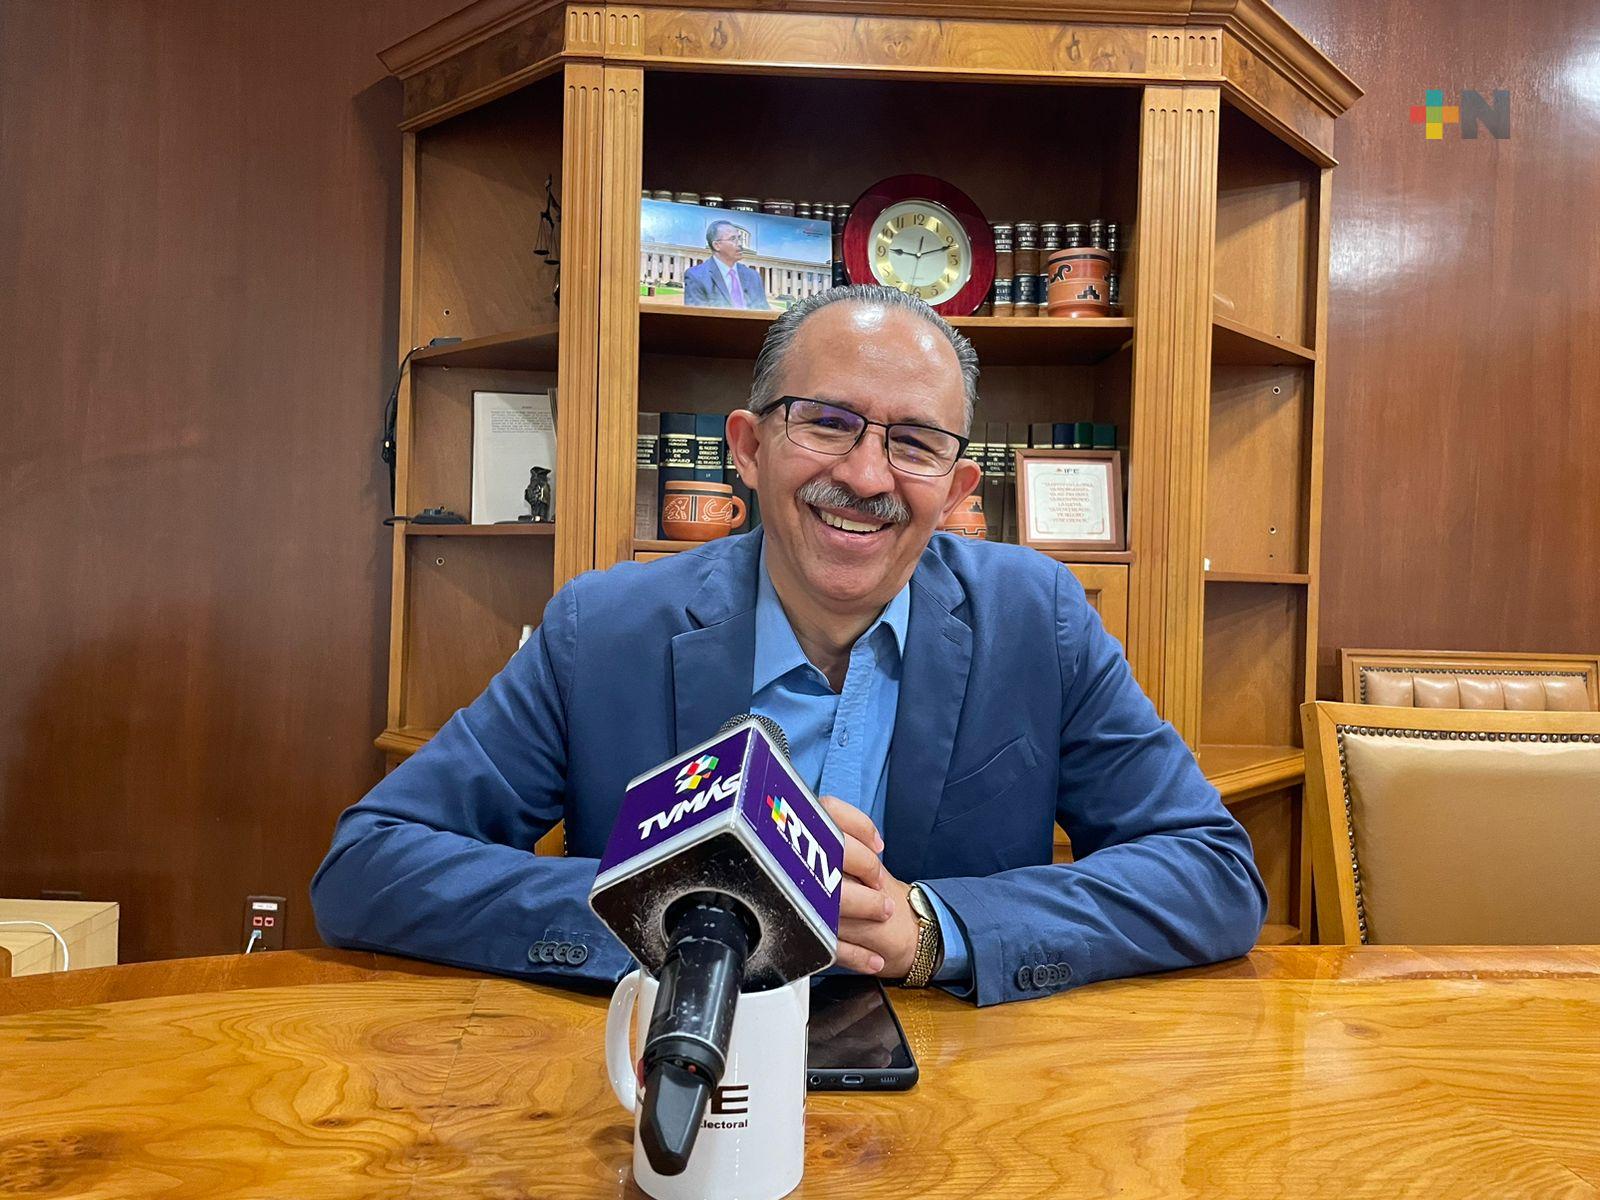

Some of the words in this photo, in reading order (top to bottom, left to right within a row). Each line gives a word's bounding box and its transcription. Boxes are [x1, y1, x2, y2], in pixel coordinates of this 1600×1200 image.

[896, 216, 904, 228] 11
[913, 214, 925, 226] 12
[882, 228, 894, 239] 10
[936, 222, 940, 233] 1
[877, 246, 886, 257] 9
[951, 254, 959, 266] 3
[931, 285, 939, 296] 5
[638, 772, 741, 840] TVMÁS
[777, 796, 842, 894] RTV
[710, 1084, 749, 1114] E
[700, 1119, 748, 1129] lectoral
